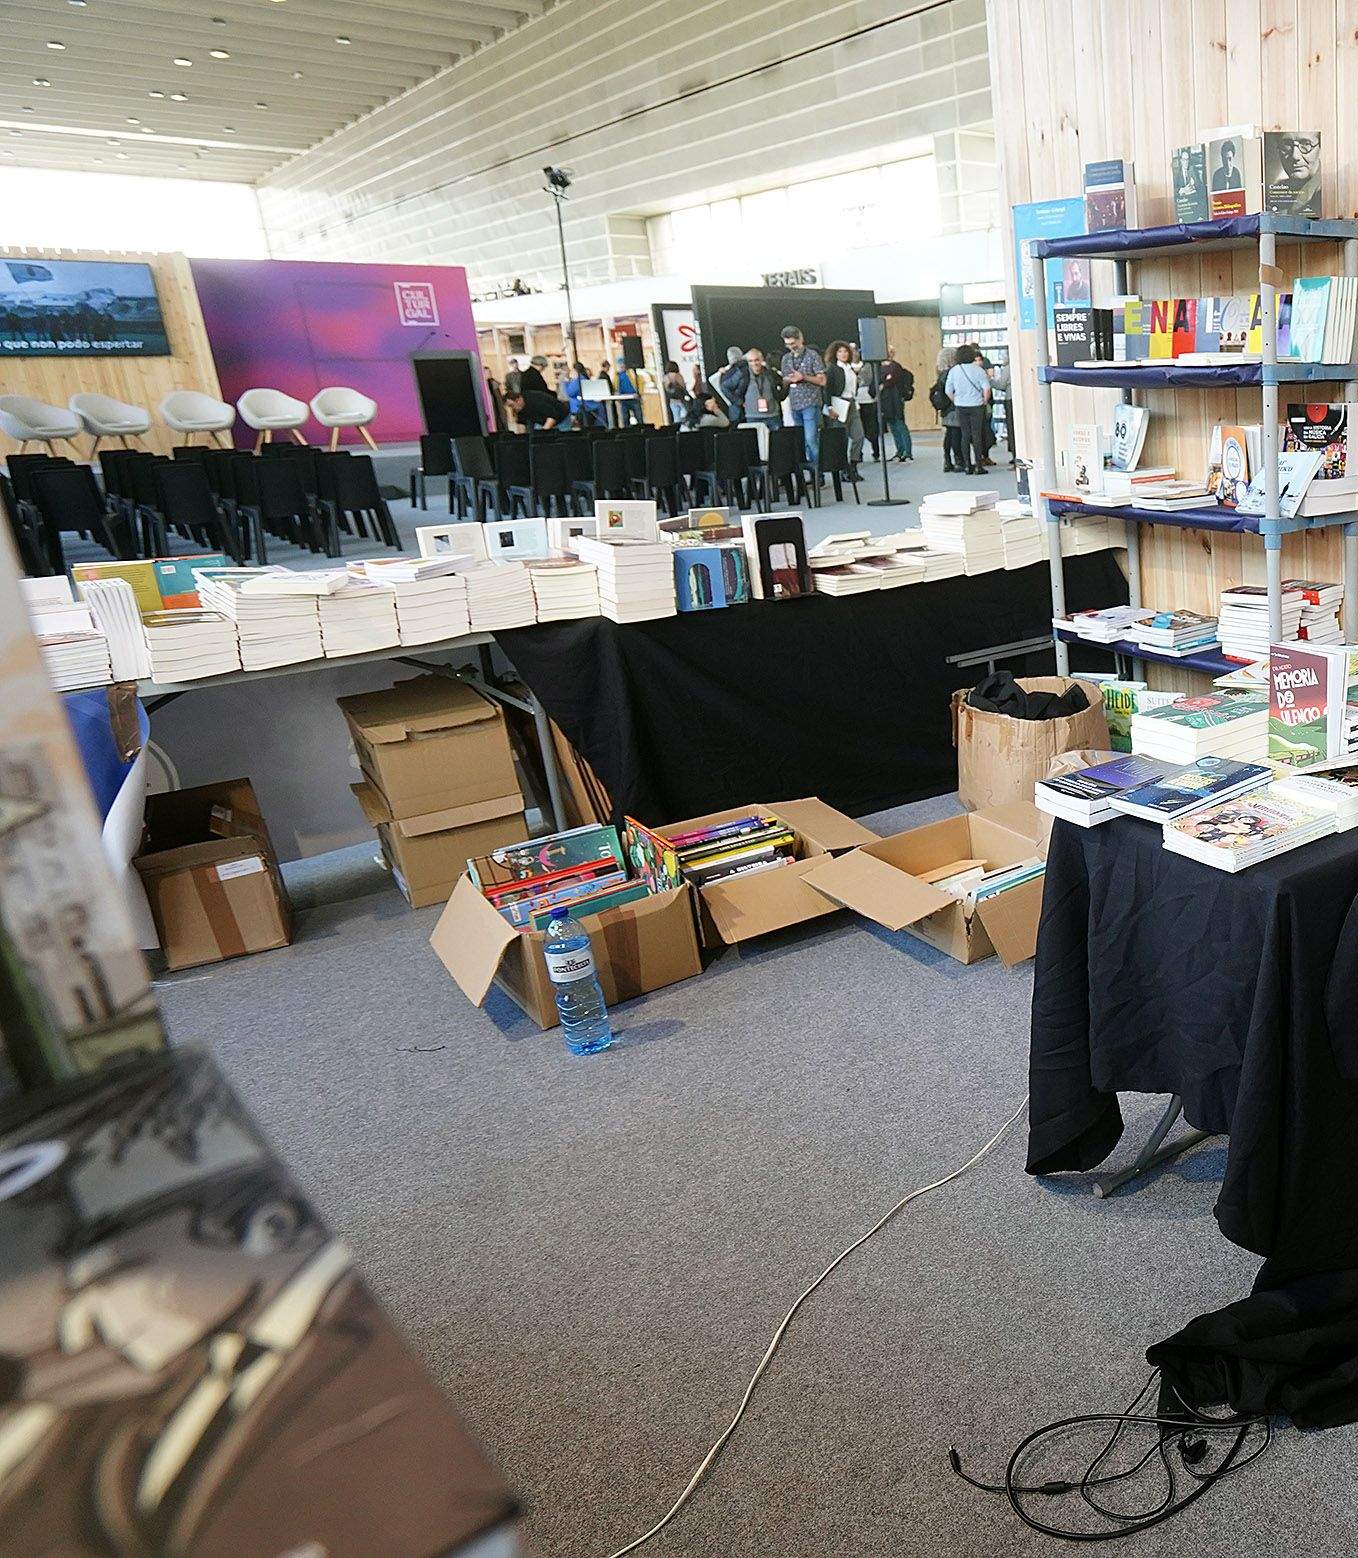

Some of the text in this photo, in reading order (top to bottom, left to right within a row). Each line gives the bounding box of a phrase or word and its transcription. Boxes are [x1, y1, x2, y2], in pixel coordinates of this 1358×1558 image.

[1056, 313, 1088, 322] SEMPRE
[1056, 323, 1084, 332] LIBRES
[1064, 332, 1087, 341] VIVAS
[3, 340, 30, 350] que
[30, 340, 56, 349] non
[91, 339, 144, 351] espertar
[1273, 668, 1319, 690] MEMORIA
